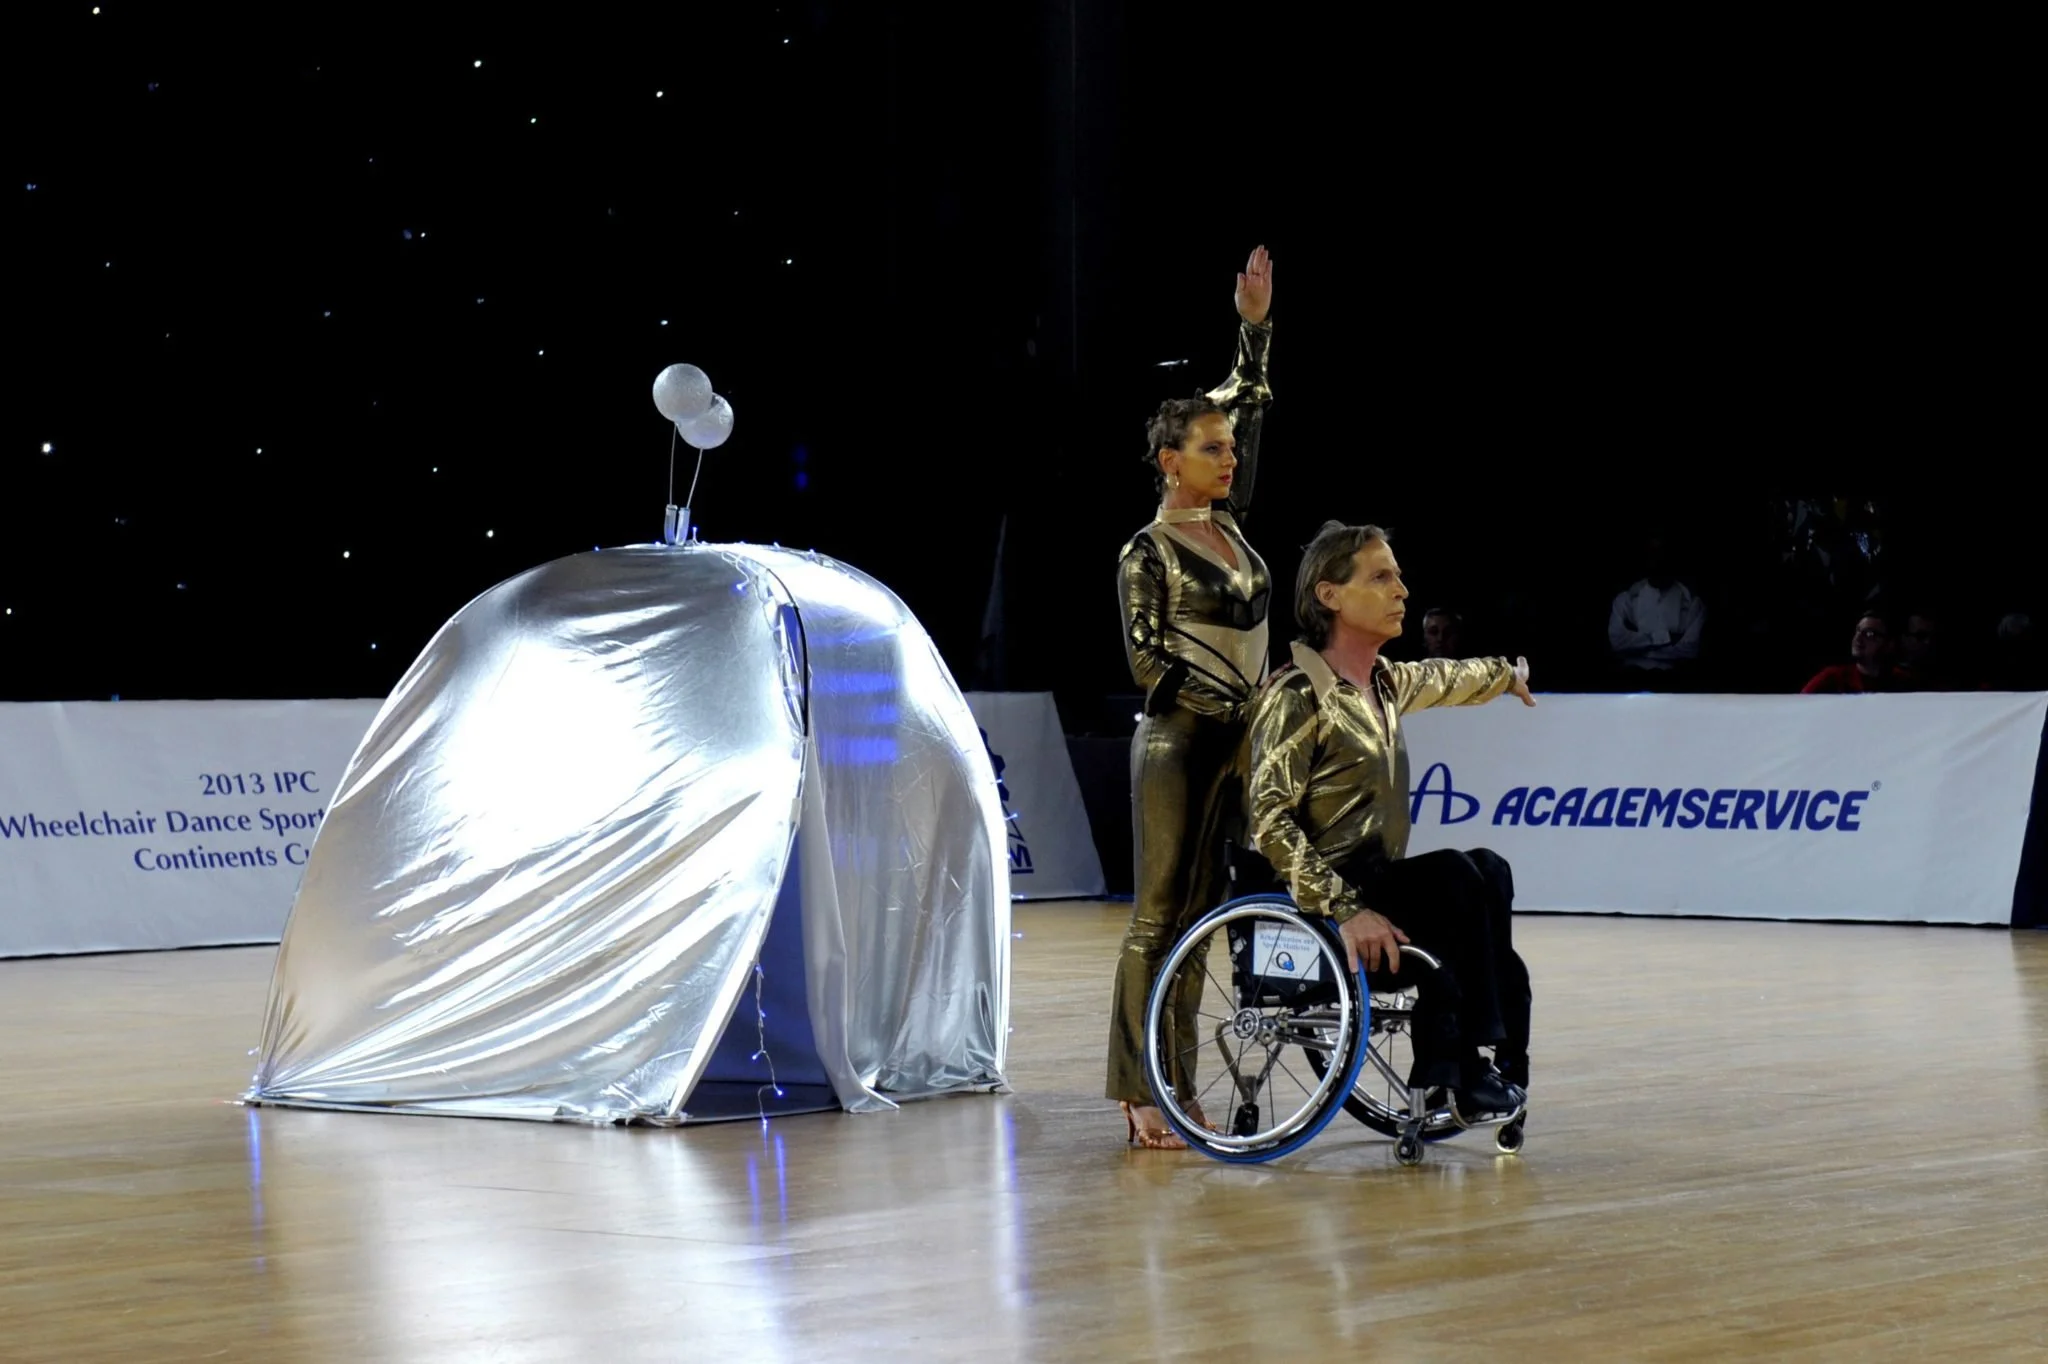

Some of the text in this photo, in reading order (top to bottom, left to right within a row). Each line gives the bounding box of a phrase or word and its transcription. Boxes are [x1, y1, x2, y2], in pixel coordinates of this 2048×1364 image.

[198, 770, 320, 796] 2013 IPC
[0, 809, 157, 839] Wheelchair
[166, 810, 252, 834] Dance
[133, 845, 278, 872] Continents
